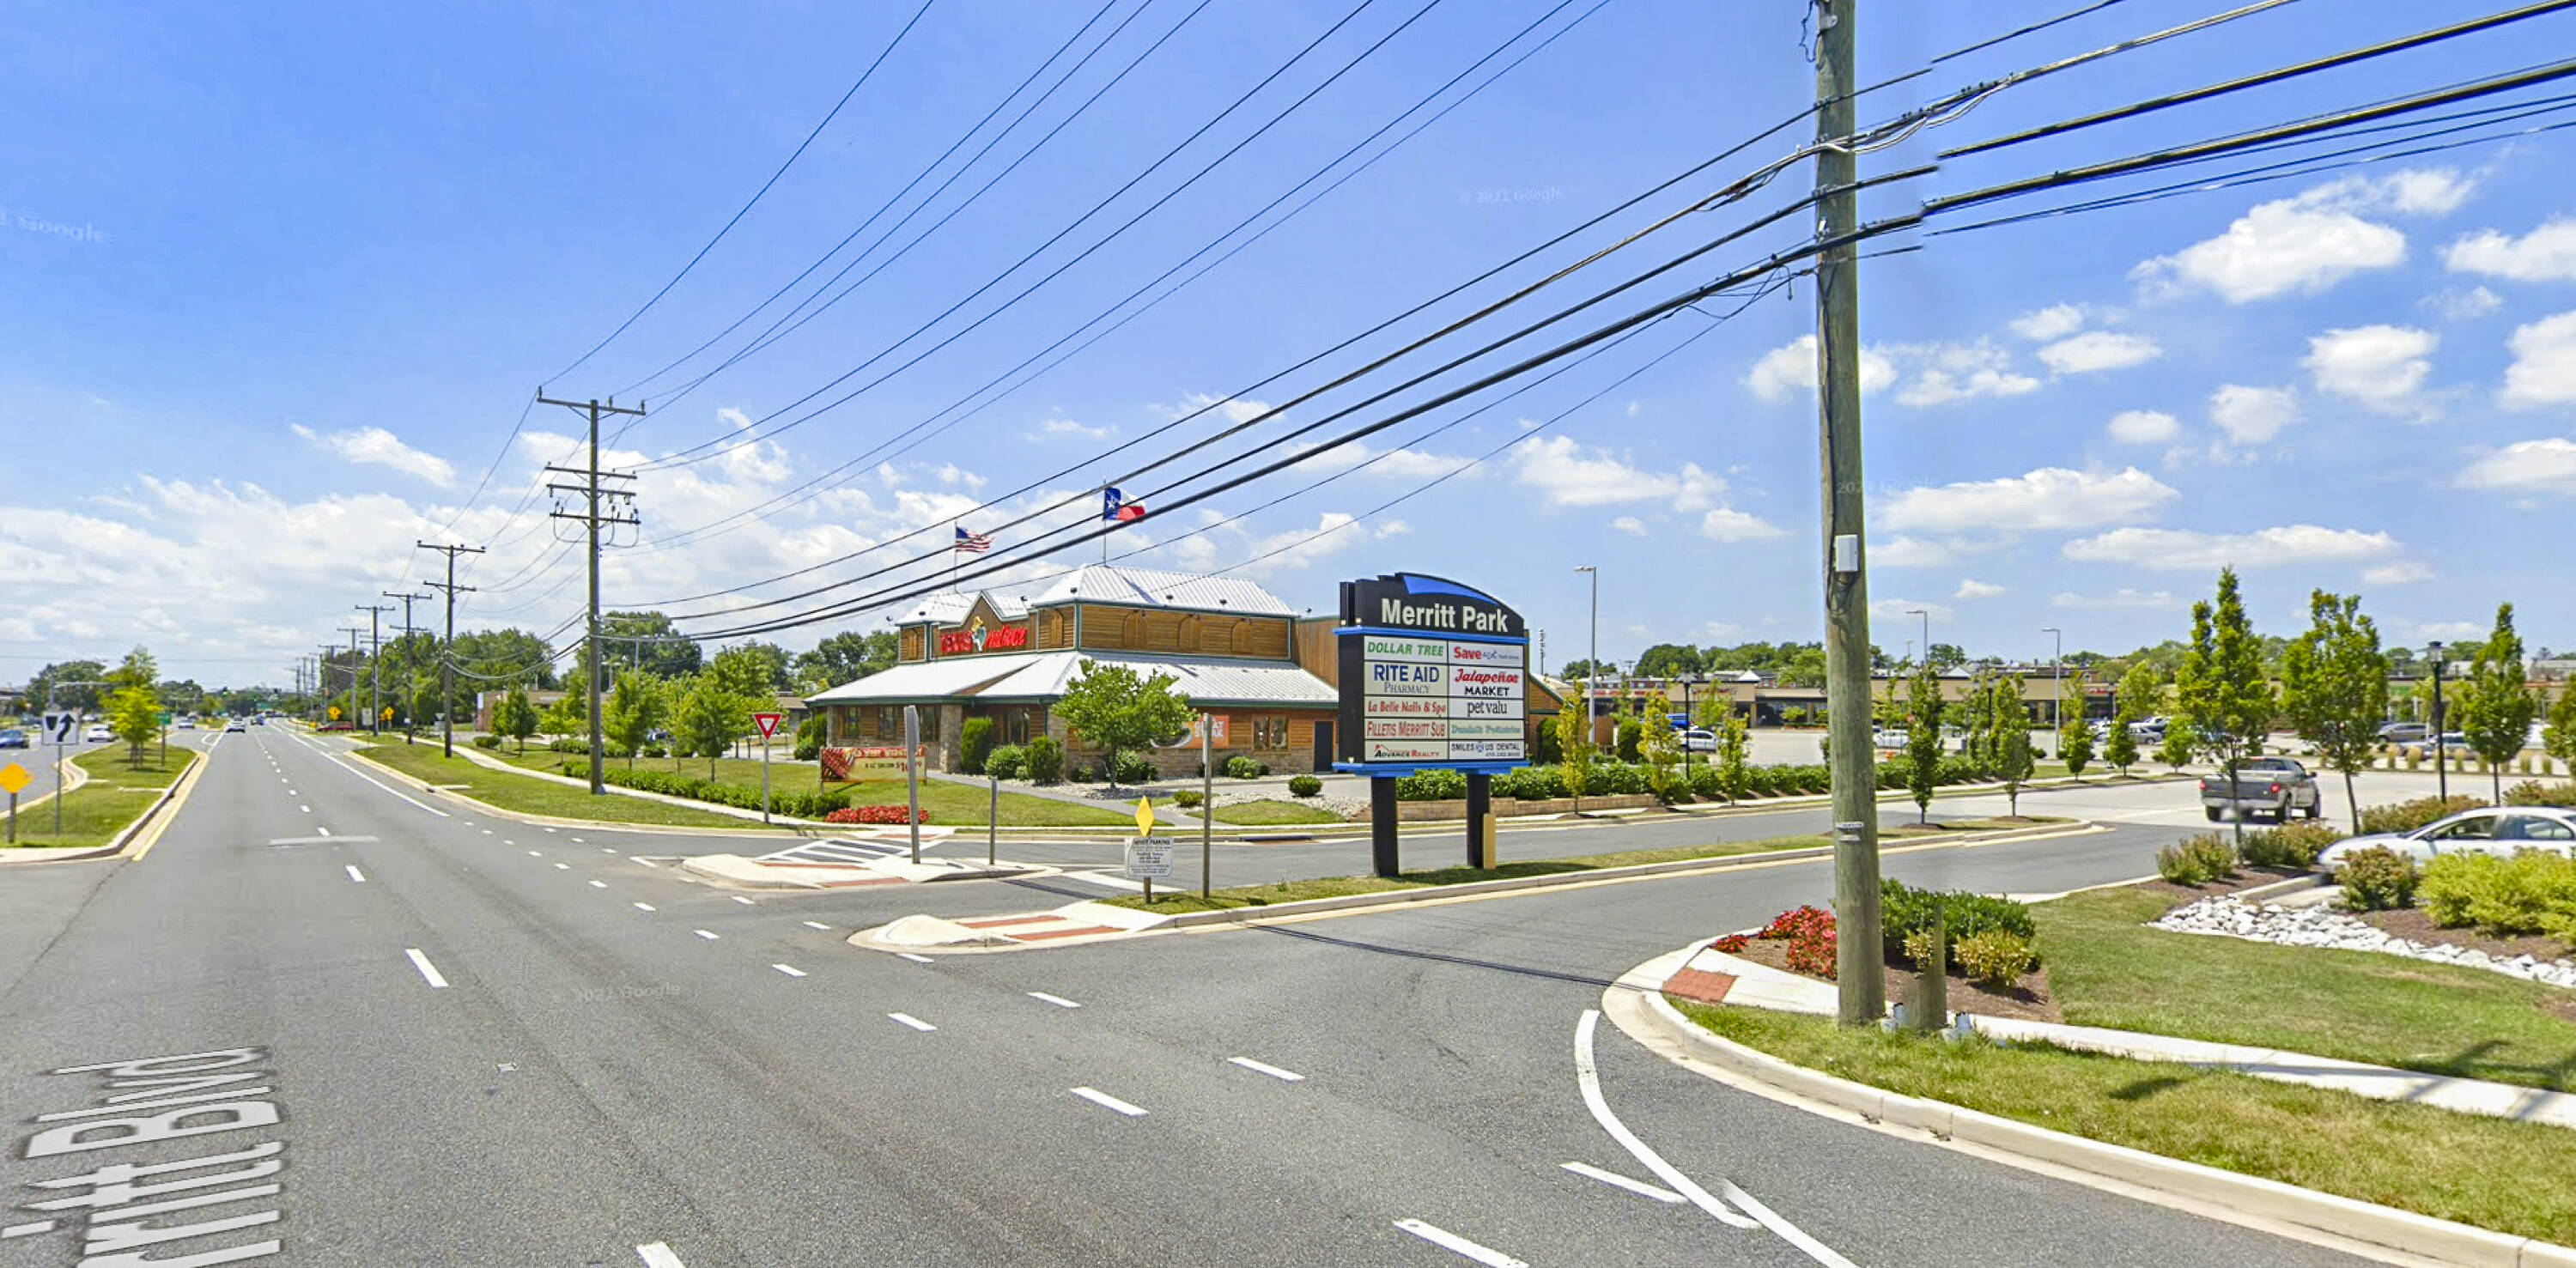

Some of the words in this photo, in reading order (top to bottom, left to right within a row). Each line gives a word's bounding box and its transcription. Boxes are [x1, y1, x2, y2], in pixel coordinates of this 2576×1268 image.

[1381, 598, 1455, 628] Merritt
[1462, 605, 1509, 633] Park
[1367, 641, 1413, 654] DOLLAR
[1418, 645, 1444, 656] TREE
[1454, 646, 1482, 660] Save
[1374, 664, 1408, 682] RITE
[1413, 666, 1440, 683] AID
[1455, 668, 1519, 685] Jalapeños
[1384, 682, 1430, 694] PHARMACY
[1464, 686, 1510, 696] MARKET
[1368, 701, 1377, 713] La
[1380, 701, 1400, 713] Belle
[1401, 701, 1421, 713] Nails
[1424, 701, 1431, 713] &
[1431, 701, 1446, 715] Spa
[1467, 701, 1485, 717] pet
[1485, 700, 1507, 714] valu
[1398, 721, 1431, 737] MERRITT
[1431, 721, 1445, 737] SUB
